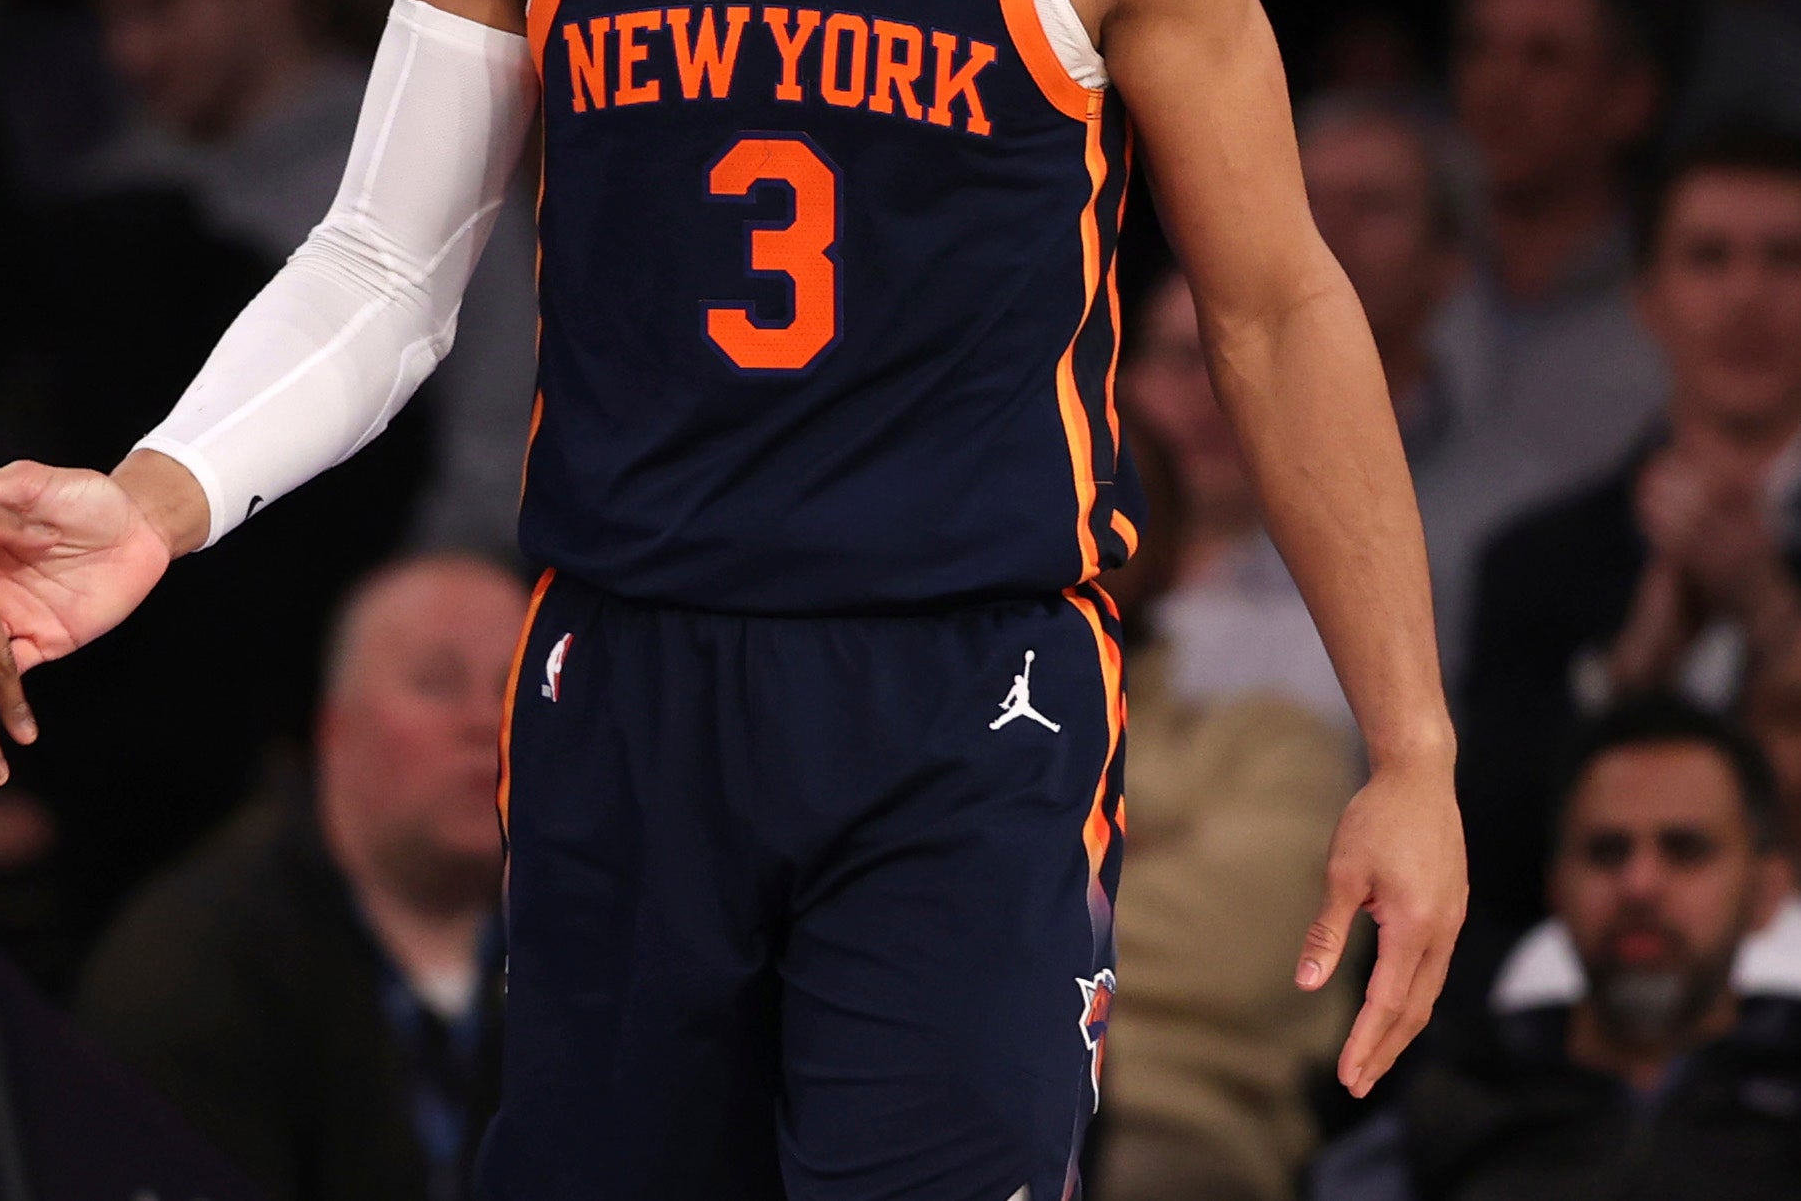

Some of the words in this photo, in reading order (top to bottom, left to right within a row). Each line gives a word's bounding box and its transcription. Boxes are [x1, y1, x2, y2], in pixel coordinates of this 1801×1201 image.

[562, 6, 752, 114] NEW
[761, 6, 1000, 137] YORK
[706, 137, 840, 370] 3
